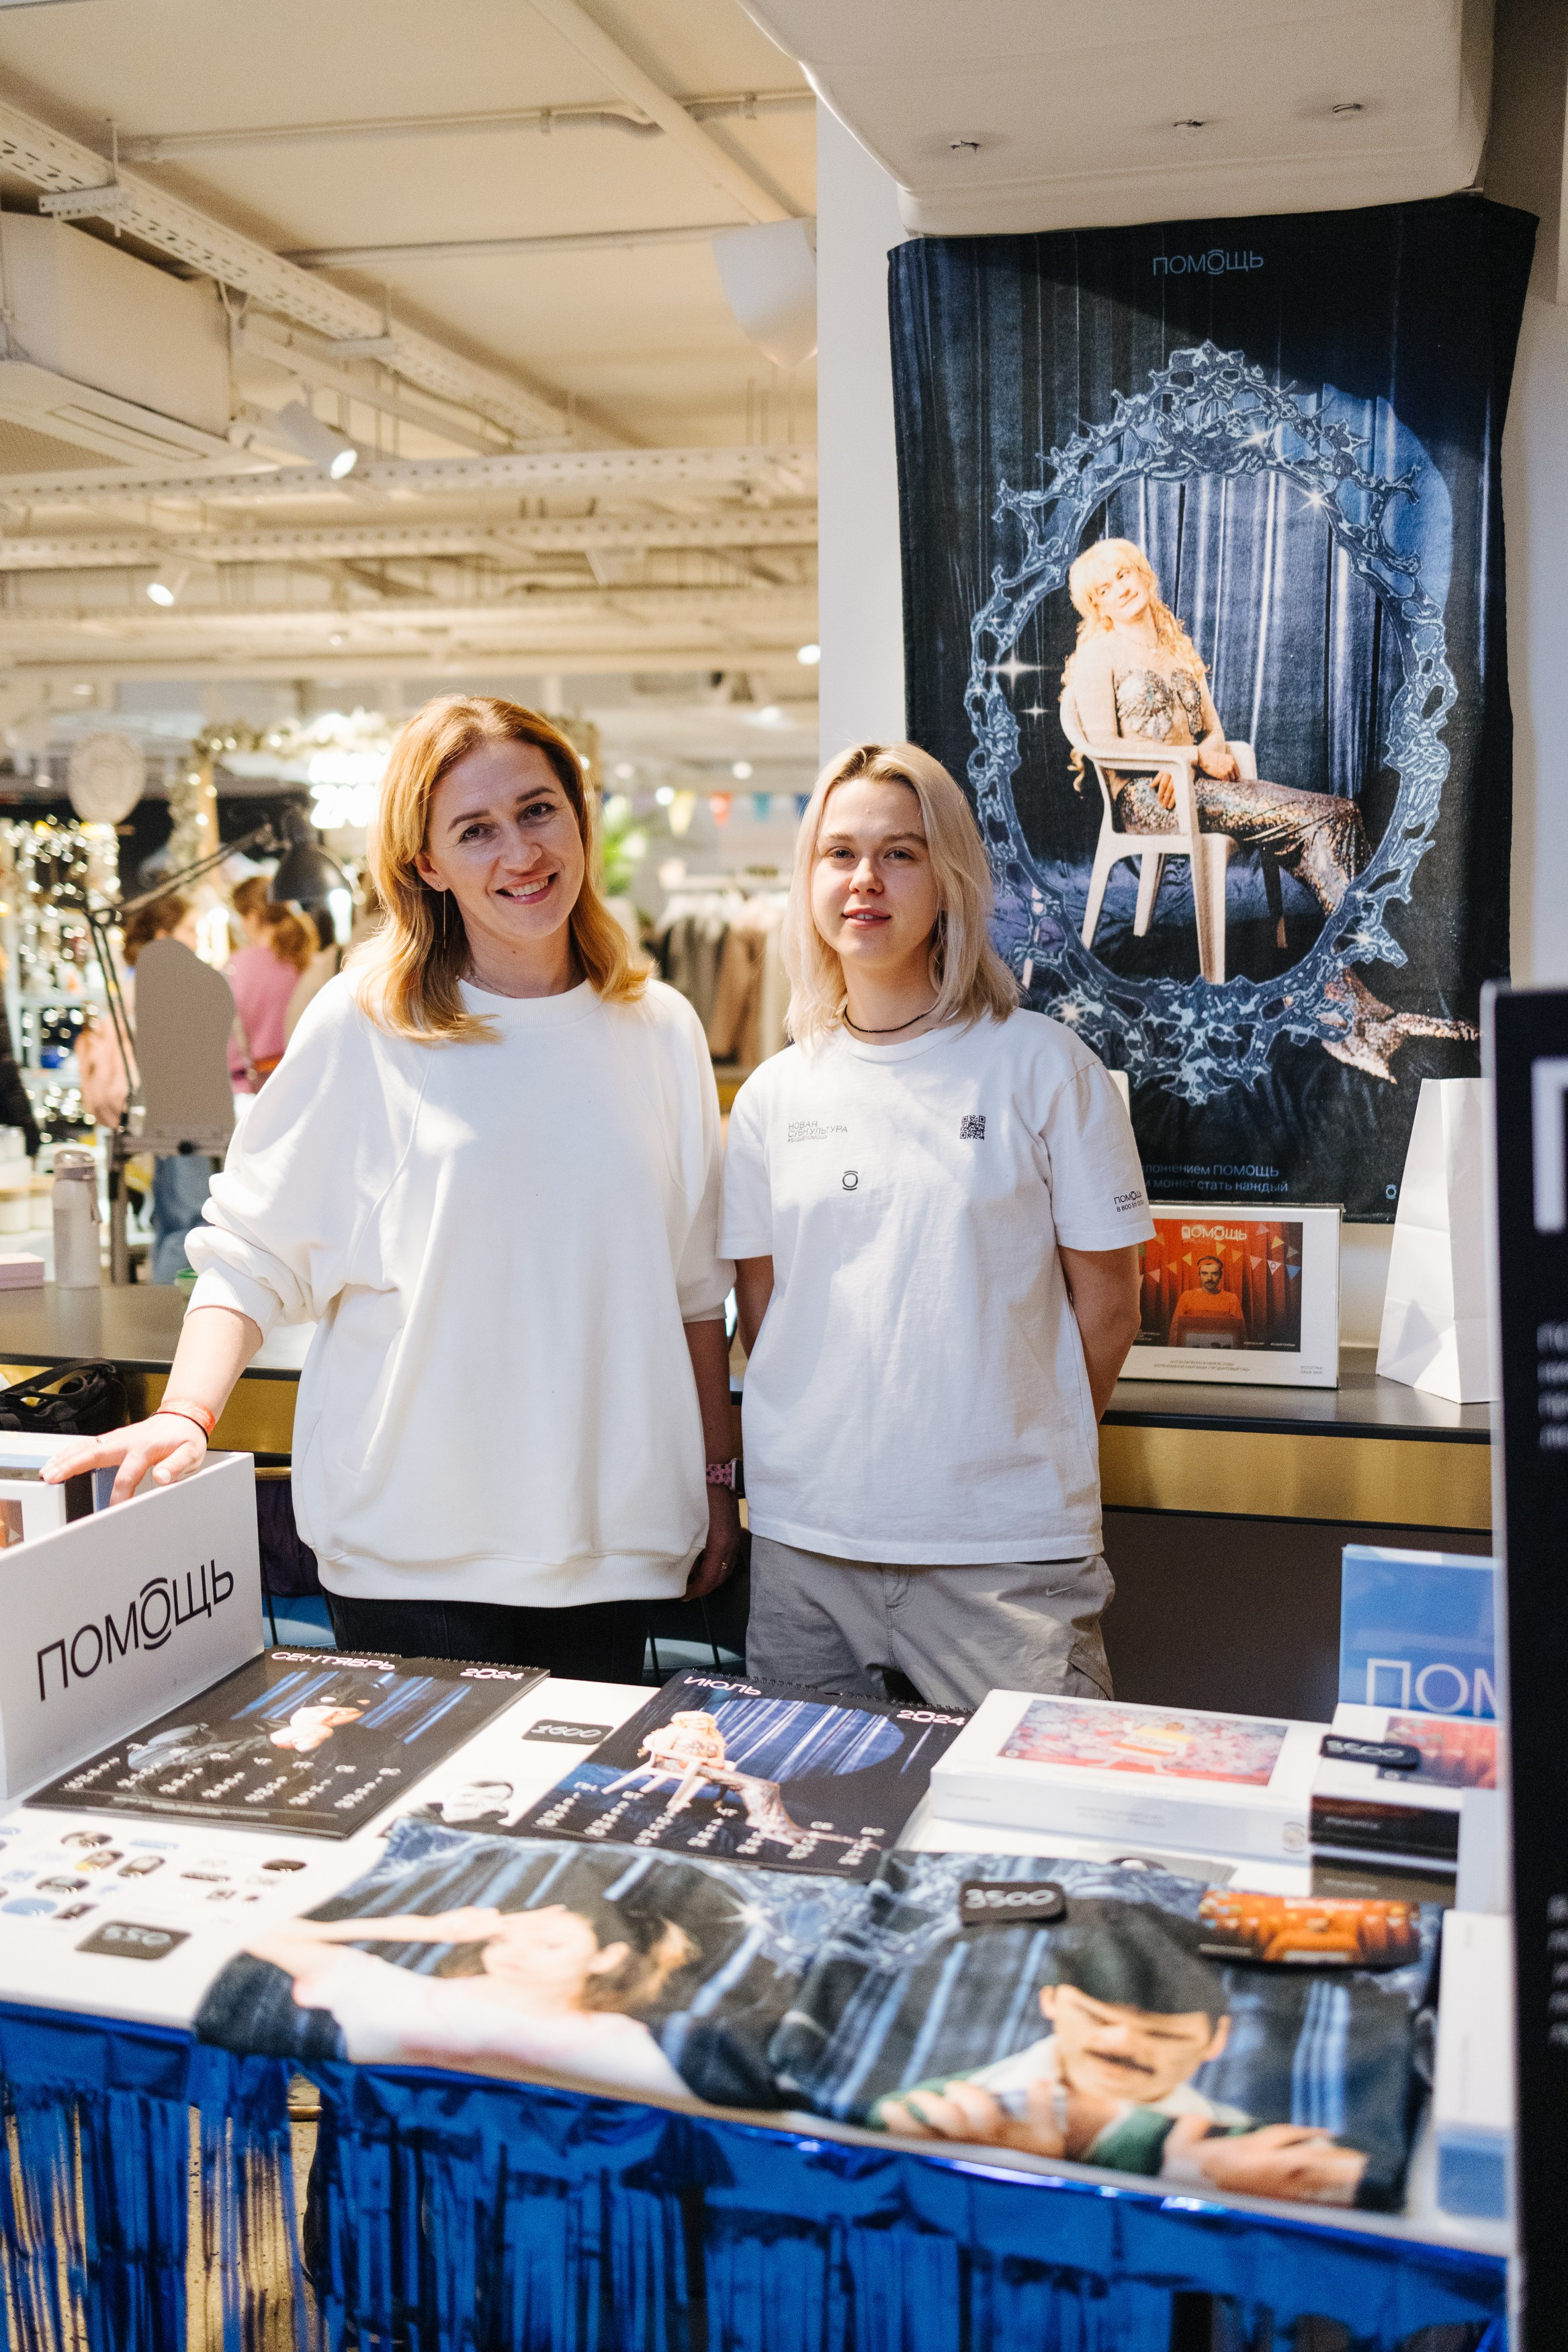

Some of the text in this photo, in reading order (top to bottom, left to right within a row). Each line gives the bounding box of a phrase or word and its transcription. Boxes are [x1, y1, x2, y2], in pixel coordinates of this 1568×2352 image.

[1153, 249, 1264, 276] ПОМОЩЬ
[788, 1121, 818, 1130] НОВАЯ
[1143, 1164, 1279, 1178] ложением ПОМОЩЬ
[1197, 1179, 1232, 1191] стать
[1121, 1203, 1132, 1211] 800
[37, 1558, 234, 1702] ПОМОЩЬ
[271, 1652, 525, 1681] СЕНТЯБРЬ 2024
[684, 1675, 967, 1727] ИЮЛЬ 2024
[530, 1724, 603, 1738] 1600
[964, 1888, 1056, 1909] 3500
